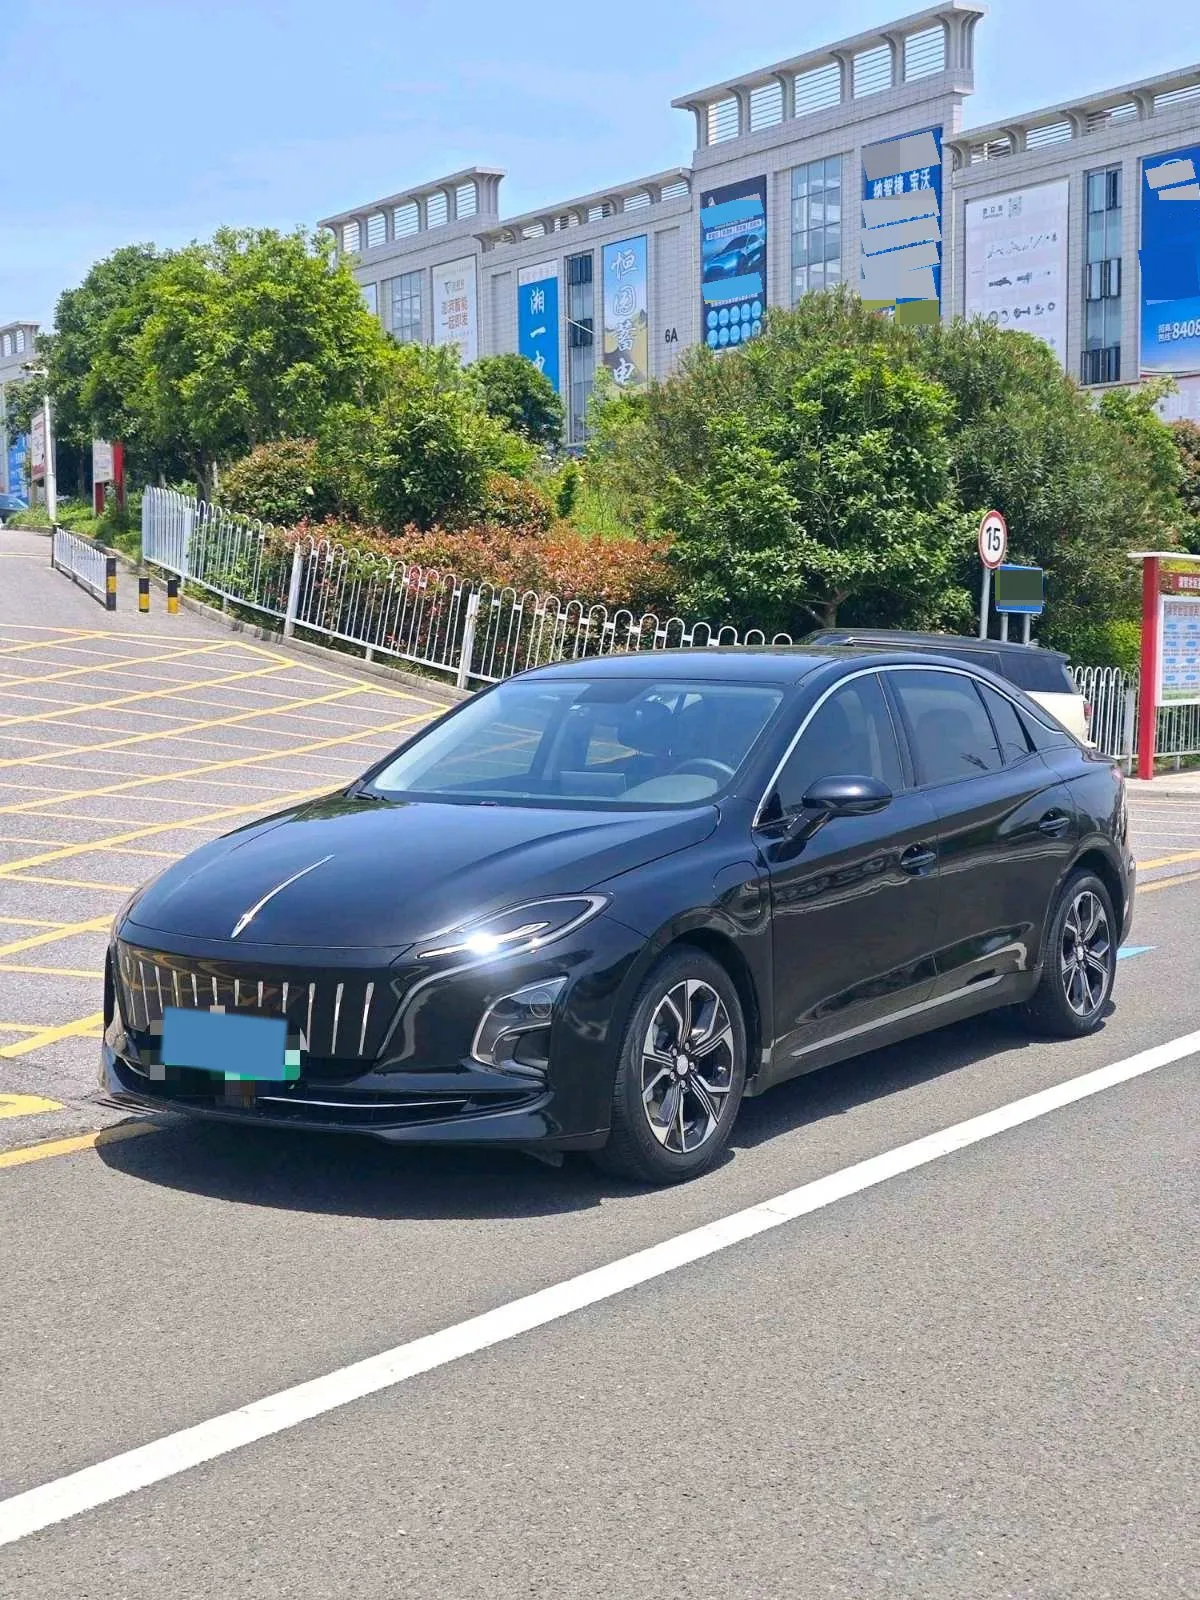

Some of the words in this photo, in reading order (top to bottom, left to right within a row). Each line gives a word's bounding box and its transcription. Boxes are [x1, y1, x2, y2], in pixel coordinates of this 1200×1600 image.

[909, 168, 931, 192] 宝沃
[664, 327, 678, 343] 6A
[1172, 318, 1200, 339] 8408
[986, 526, 1001, 551] 15
